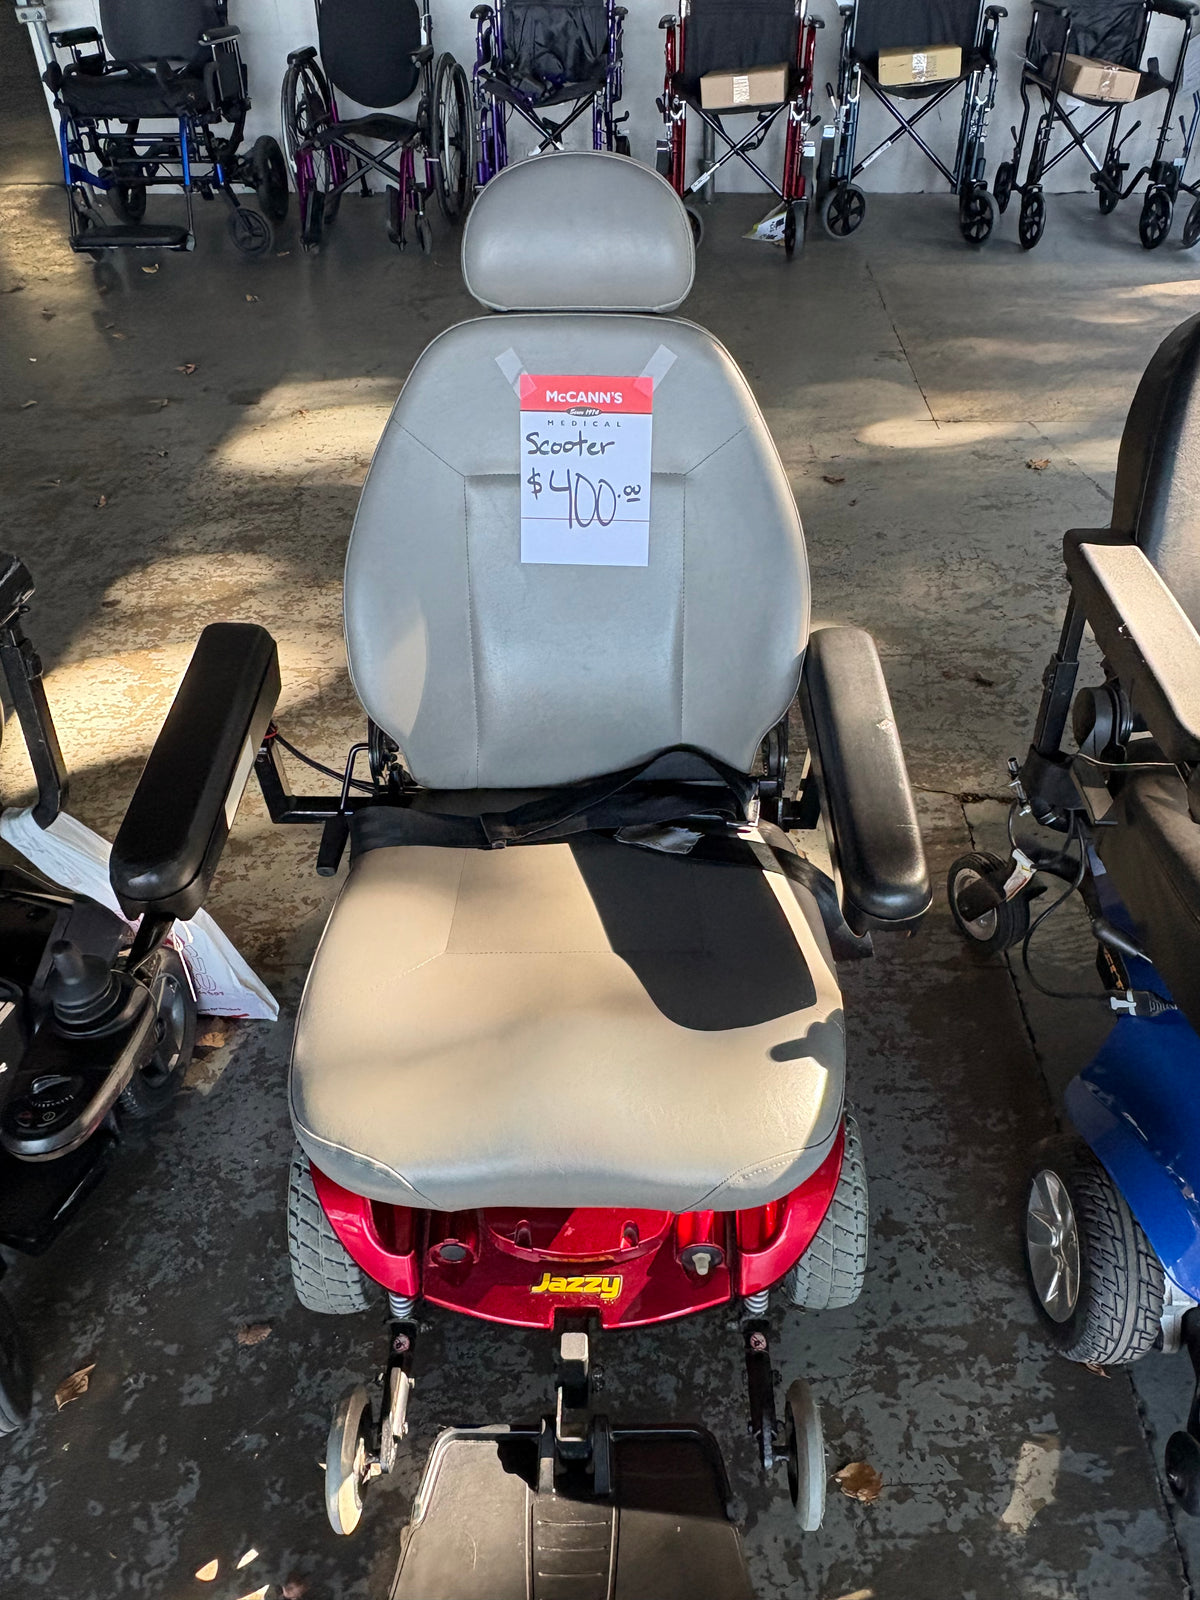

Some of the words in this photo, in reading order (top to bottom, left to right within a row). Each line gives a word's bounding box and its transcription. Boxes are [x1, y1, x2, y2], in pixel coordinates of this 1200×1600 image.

[545, 390, 623, 404] McCANN'S
[547, 419, 622, 428] MEDICAL
[525, 430, 615, 457] Scooter
[530, 1272, 622, 1300] Jazzy
